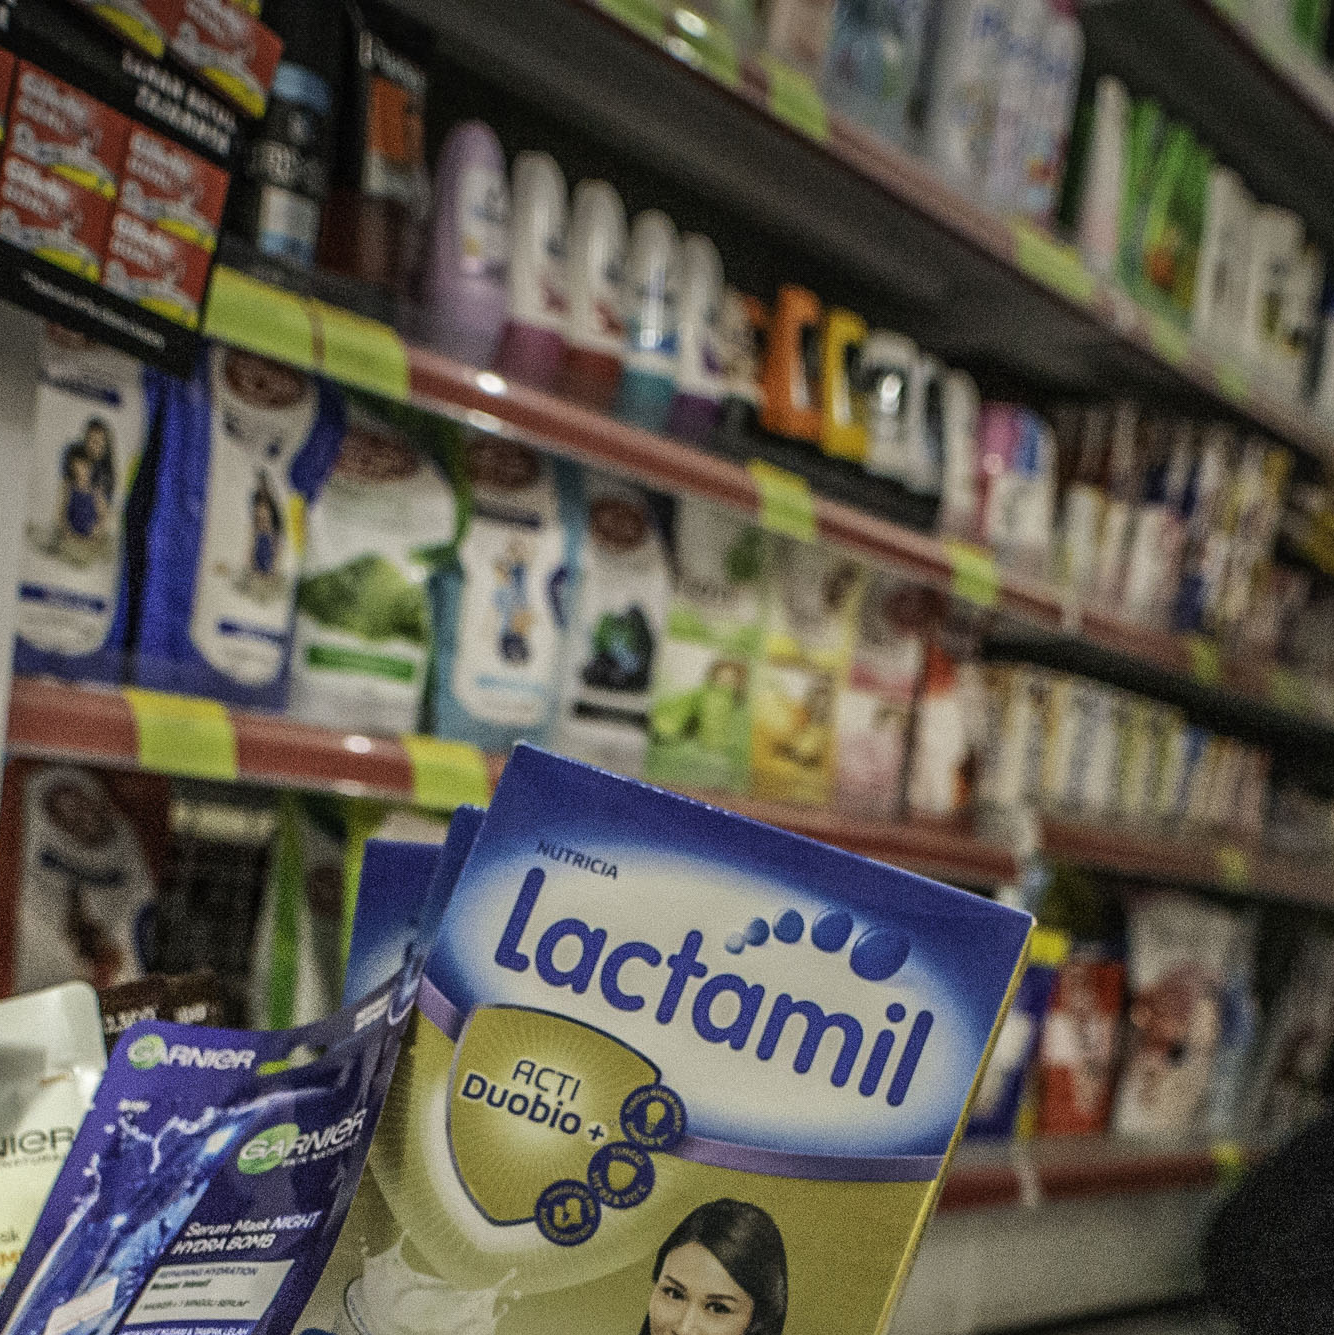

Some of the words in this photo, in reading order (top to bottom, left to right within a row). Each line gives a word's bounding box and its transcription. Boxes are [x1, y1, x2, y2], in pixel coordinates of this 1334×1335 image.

[537, 841, 618, 880] NUTRICIA
[494, 868, 933, 1107] Lactamil
[127, 1037, 256, 1070] GARNIER
[512, 1059, 581, 1101] ACTI
[461, 1073, 581, 1135] Duobio
[239, 1108, 367, 1160] GARNIER
[172, 1237, 227, 1255] HYDRA
[226, 1233, 277, 1251] BOMB
[185, 1221, 232, 1238] Serum
[270, 1211, 323, 1231] NIGHT
